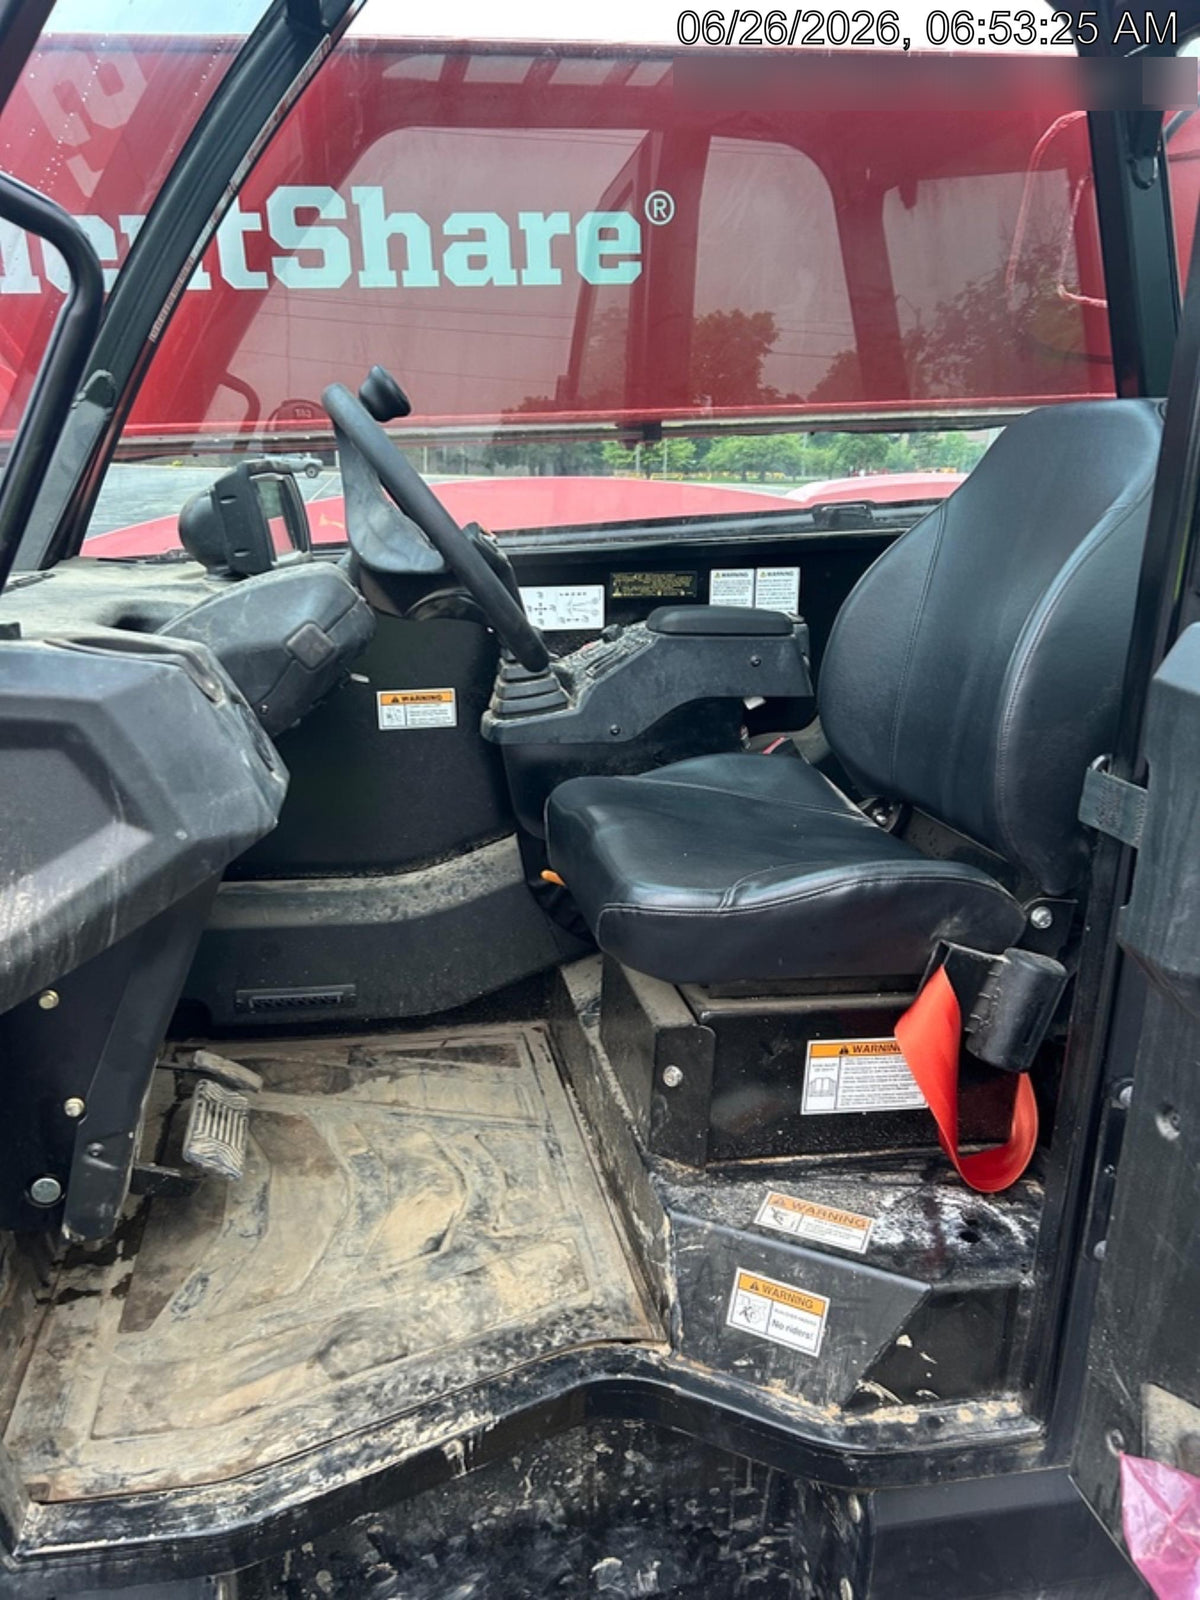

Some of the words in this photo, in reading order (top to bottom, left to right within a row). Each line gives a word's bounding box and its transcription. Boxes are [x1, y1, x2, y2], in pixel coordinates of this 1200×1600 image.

[852, 1043, 902, 1054] WARNIN
[792, 1201, 866, 1228] WARNING
[762, 1284, 814, 1309] WARNING
[771, 1319, 785, 1330] No
[785, 1323, 814, 1341] riders!
